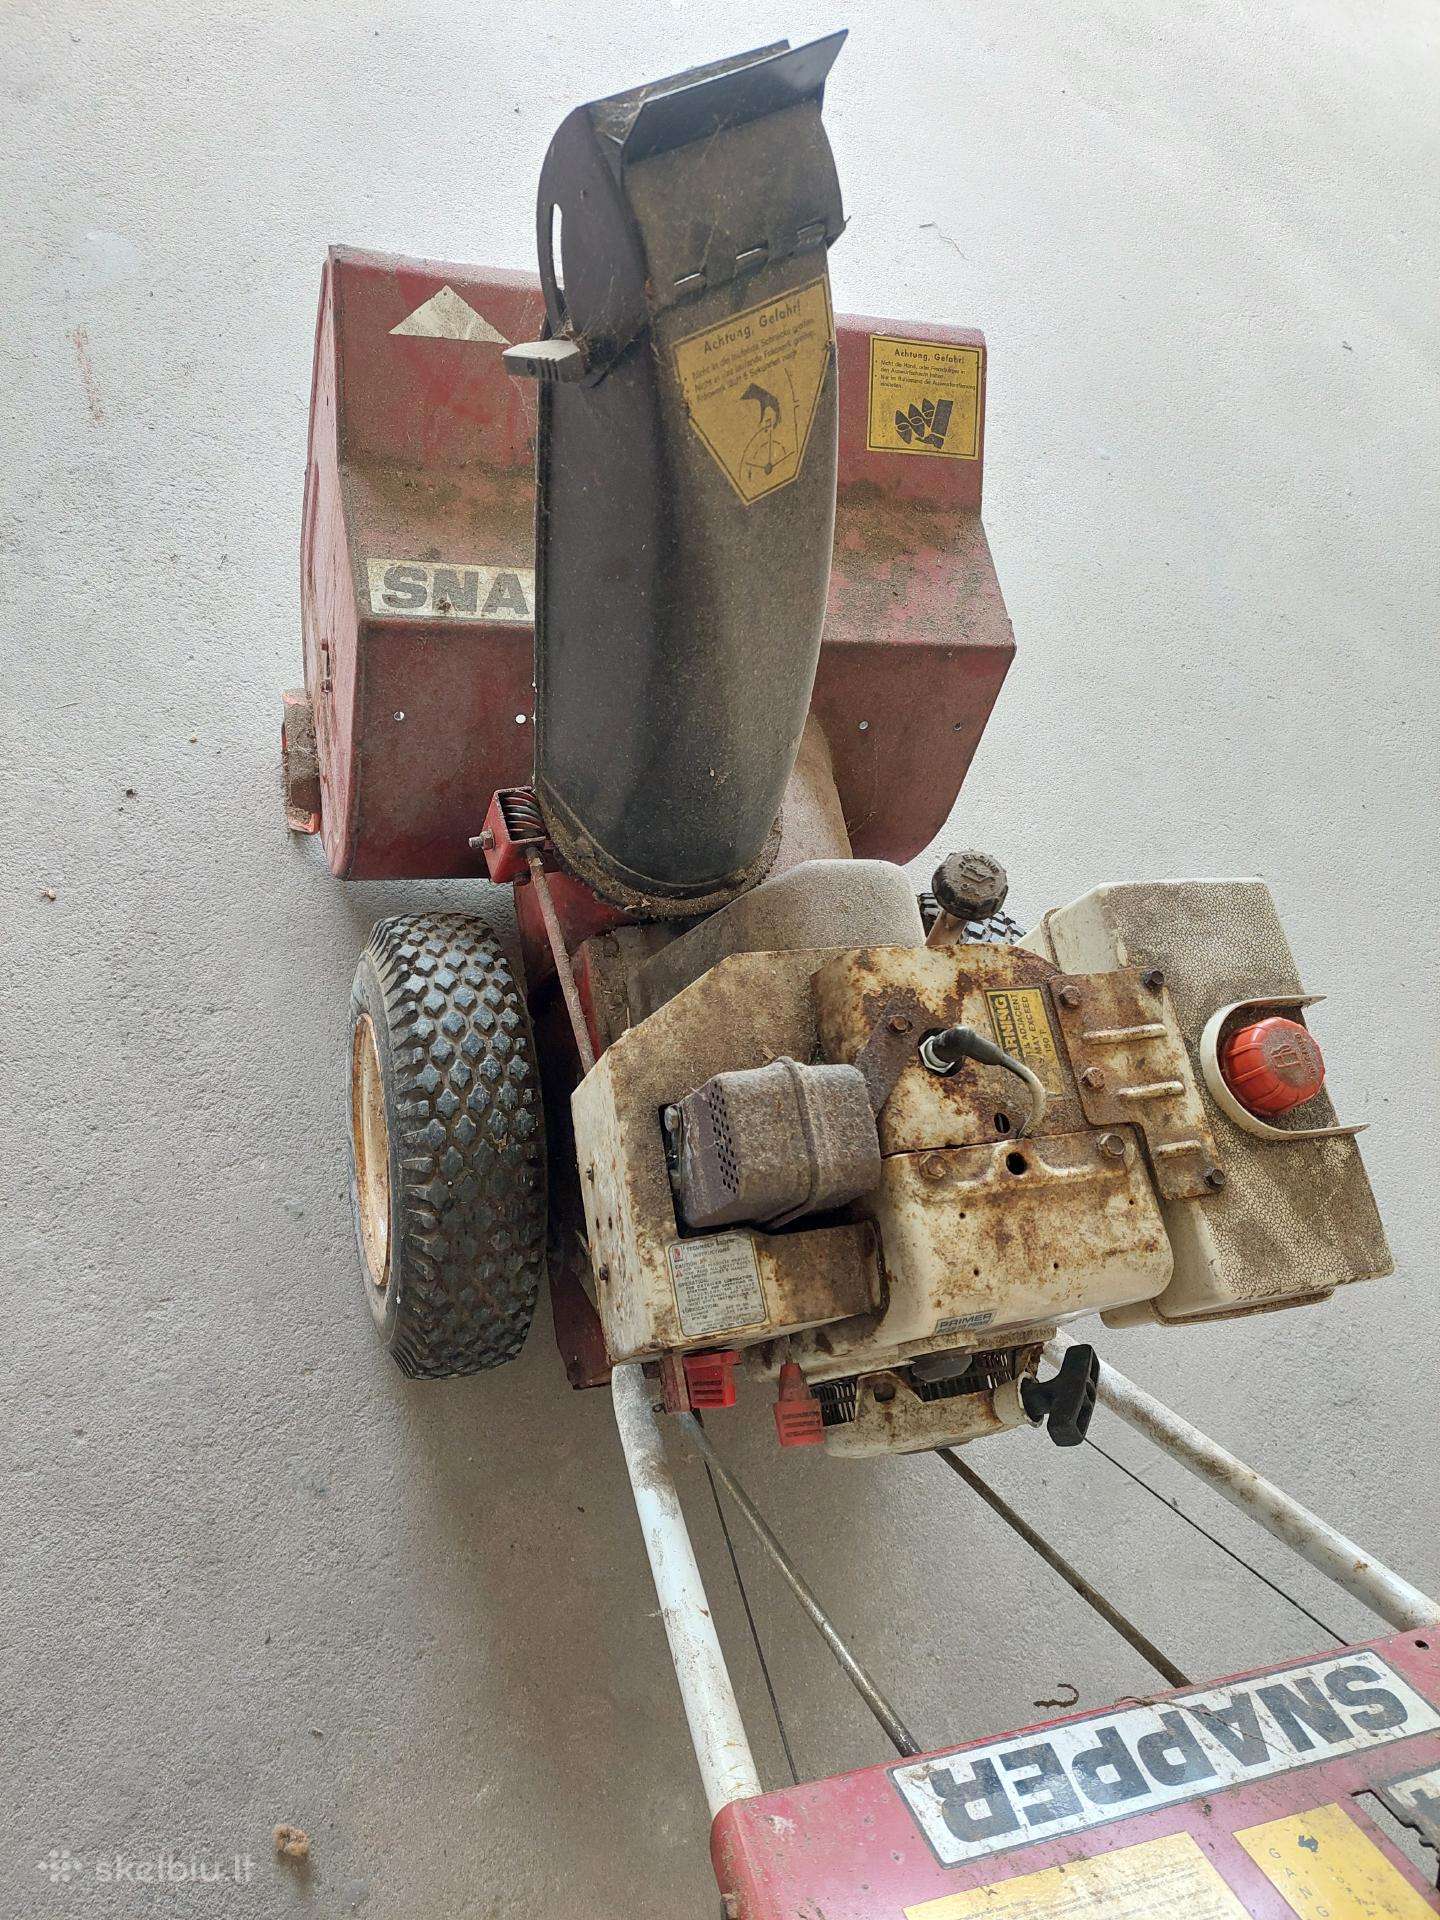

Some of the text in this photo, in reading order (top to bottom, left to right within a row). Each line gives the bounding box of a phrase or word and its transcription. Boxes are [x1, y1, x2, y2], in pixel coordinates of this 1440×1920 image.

[934, 353, 965, 364] Gefahr!
[994, 996, 1019, 1060] ARNING
[1011, 994, 1027, 1040] ADJACENT
[1021, 996, 1036, 1033] EXCEED
[1042, 1037, 1052, 1054] 150
[940, 1312, 992, 1329] PRIMER
[931, 1664, 1409, 1843] SNAPPER
